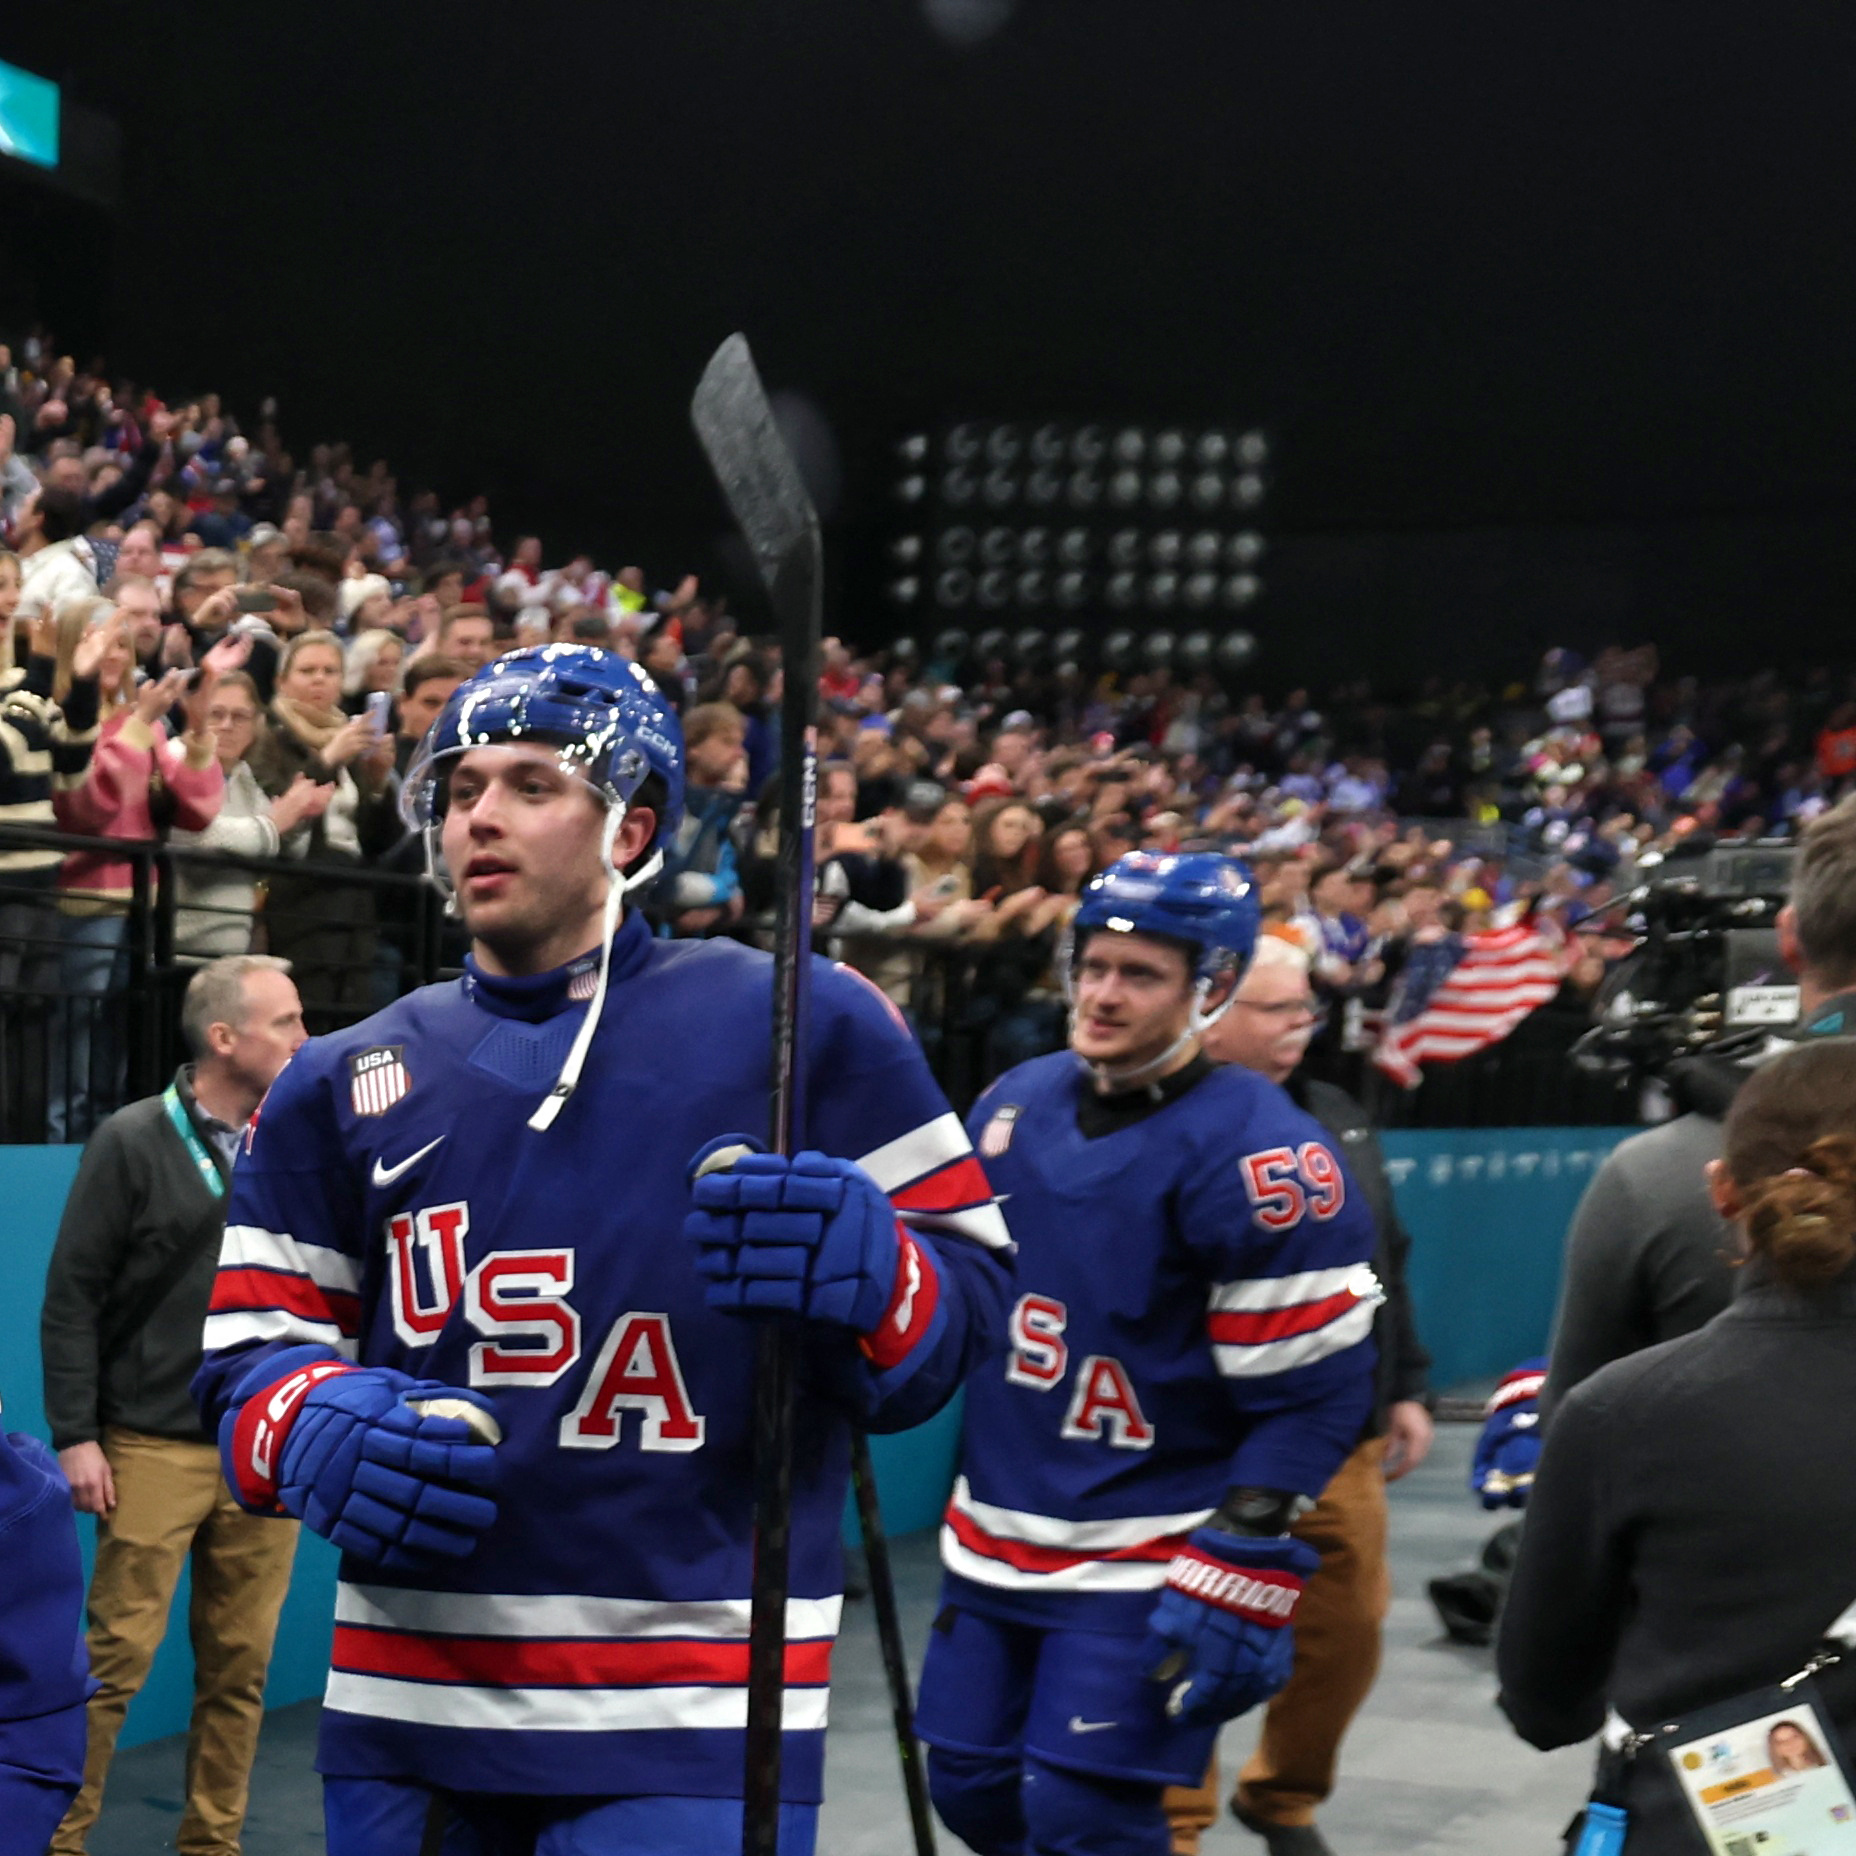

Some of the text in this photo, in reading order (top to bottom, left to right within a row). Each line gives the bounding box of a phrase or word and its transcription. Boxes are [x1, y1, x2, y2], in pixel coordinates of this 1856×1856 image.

[634, 725, 677, 758] CCM
[355, 1049, 395, 1073] USA
[1240, 1141, 1347, 1233] 59
[386, 1200, 706, 1453] USA
